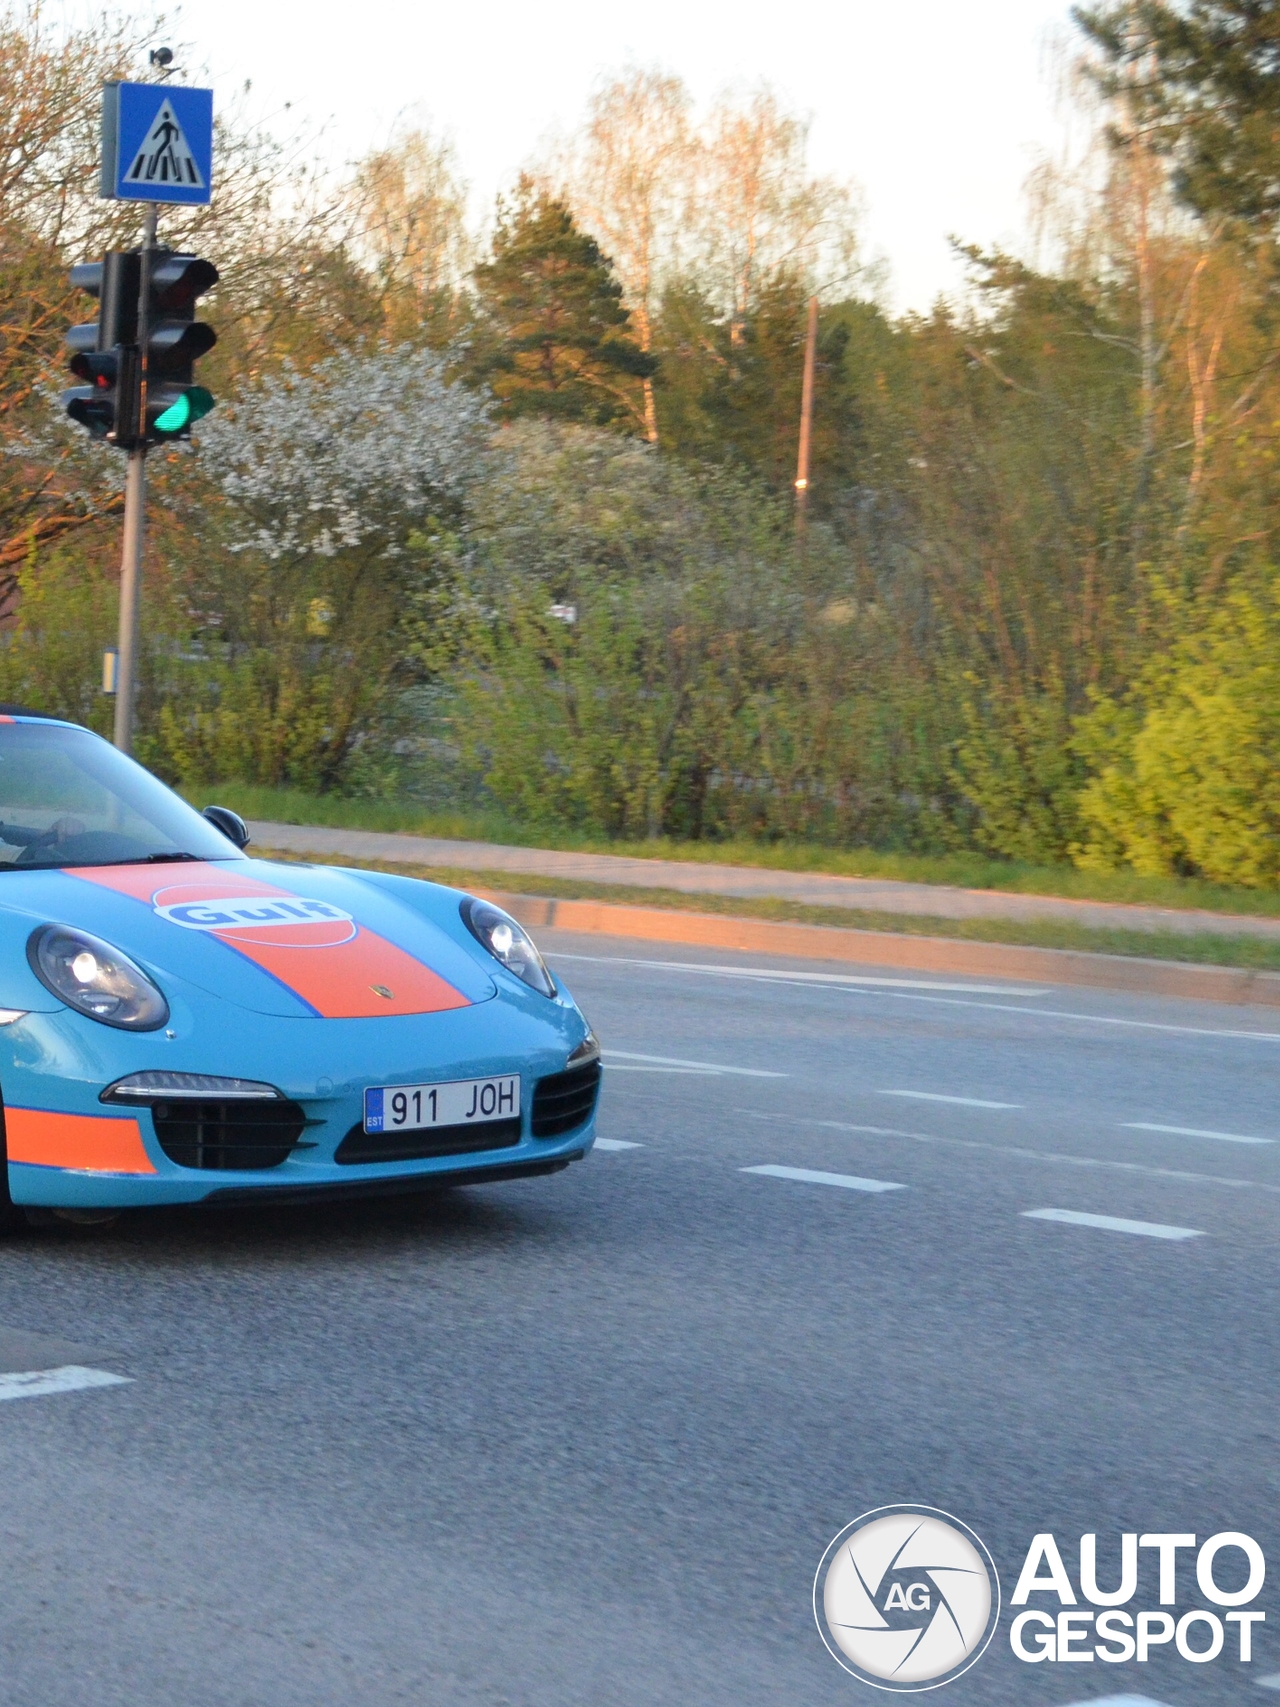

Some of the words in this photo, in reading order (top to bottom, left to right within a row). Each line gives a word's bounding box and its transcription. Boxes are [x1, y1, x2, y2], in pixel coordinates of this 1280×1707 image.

[168, 902, 337, 925] Gulf
[392, 1090, 438, 1124] 911
[466, 1081, 513, 1118] JOH
[367, 1116, 383, 1127] EST
